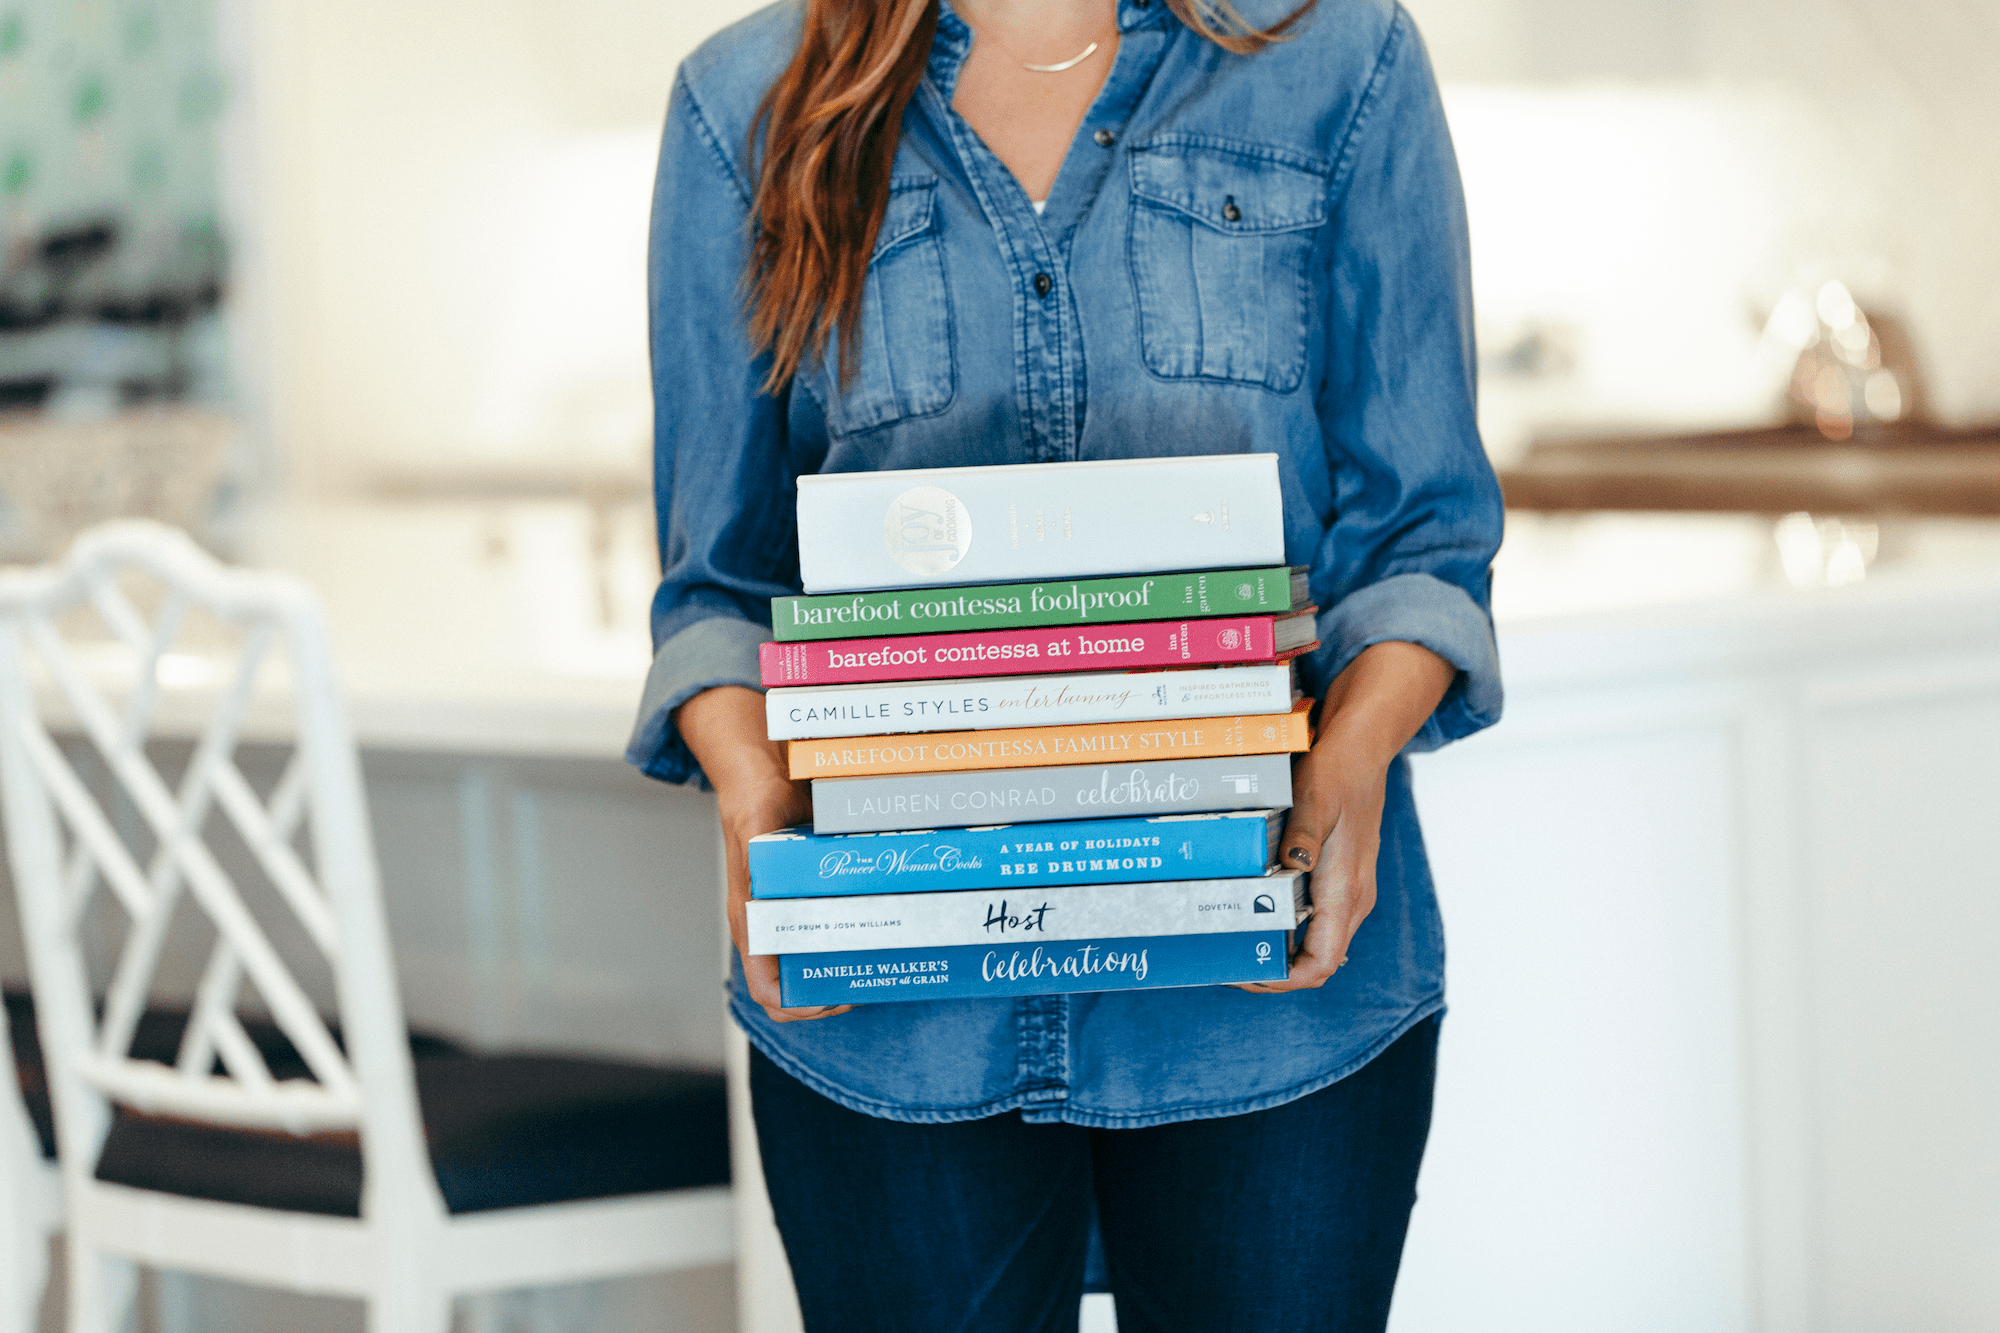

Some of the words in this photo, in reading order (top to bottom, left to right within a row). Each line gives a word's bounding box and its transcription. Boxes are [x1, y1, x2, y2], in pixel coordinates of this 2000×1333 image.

[945, 499, 957, 542] COOKING
[933, 528, 944, 541] OF
[791, 597, 904, 625] barefoot
[910, 596, 1023, 619] contessa
[1030, 580, 1154, 618] foolproof
[1182, 586, 1193, 604] ina
[1198, 576, 1211, 612] garten
[1257, 577, 1268, 605] potter
[1168, 633, 1178, 651] ina
[1180, 623, 1191, 660] garten
[1243, 625, 1253, 651] potter
[827, 646, 927, 668] barefoot
[934, 643, 1040, 662] contessa
[1047, 639, 1071, 656] at
[1078, 636, 1145, 655] home
[1179, 683, 1216, 692] INSPIRED
[1219, 681, 1270, 690] GATHERINGS
[1194, 692, 1245, 701] EFFORTLESS
[1247, 690, 1272, 698] STYLE
[789, 703, 891, 722] CAMILLE
[903, 698, 989, 716] STYLES
[997, 685, 1143, 710] entertaining
[814, 745, 929, 767] BAREFOOT
[934, 740, 1048, 761] CONTESSA
[1055, 734, 1133, 753] FAMILY
[1140, 730, 1204, 749] STYLE
[1225, 728, 1233, 745] INA
[847, 794, 940, 816] LAUREN
[951, 787, 1056, 810] CONRAD
[1076, 768, 1199, 805] celebrate
[1000, 844, 1009, 854] A
[1015, 842, 1054, 853] YEAR
[1060, 840, 1079, 850] OF
[1085, 836, 1161, 850] HOLIDAYS
[818, 850, 876, 878] Pioneer
[876, 844, 938, 876] Woman
[934, 845, 982, 872] Cooks
[1000, 863, 1038, 875] REE
[1048, 857, 1162, 873] DRUMMOND
[982, 899, 1057, 933] Host
[1198, 903, 1242, 912] DOVETAIL
[833, 922, 856, 930] JOSH
[859, 920, 902, 928] WILLIAMS
[803, 965, 874, 979] DANIELLE
[877, 960, 949, 974] WALKER'S
[981, 944, 1149, 982] Celebrations
[849, 977, 898, 988] AGAINST
[900, 976, 911, 985] all
[912, 974, 949, 985] GRAIN
